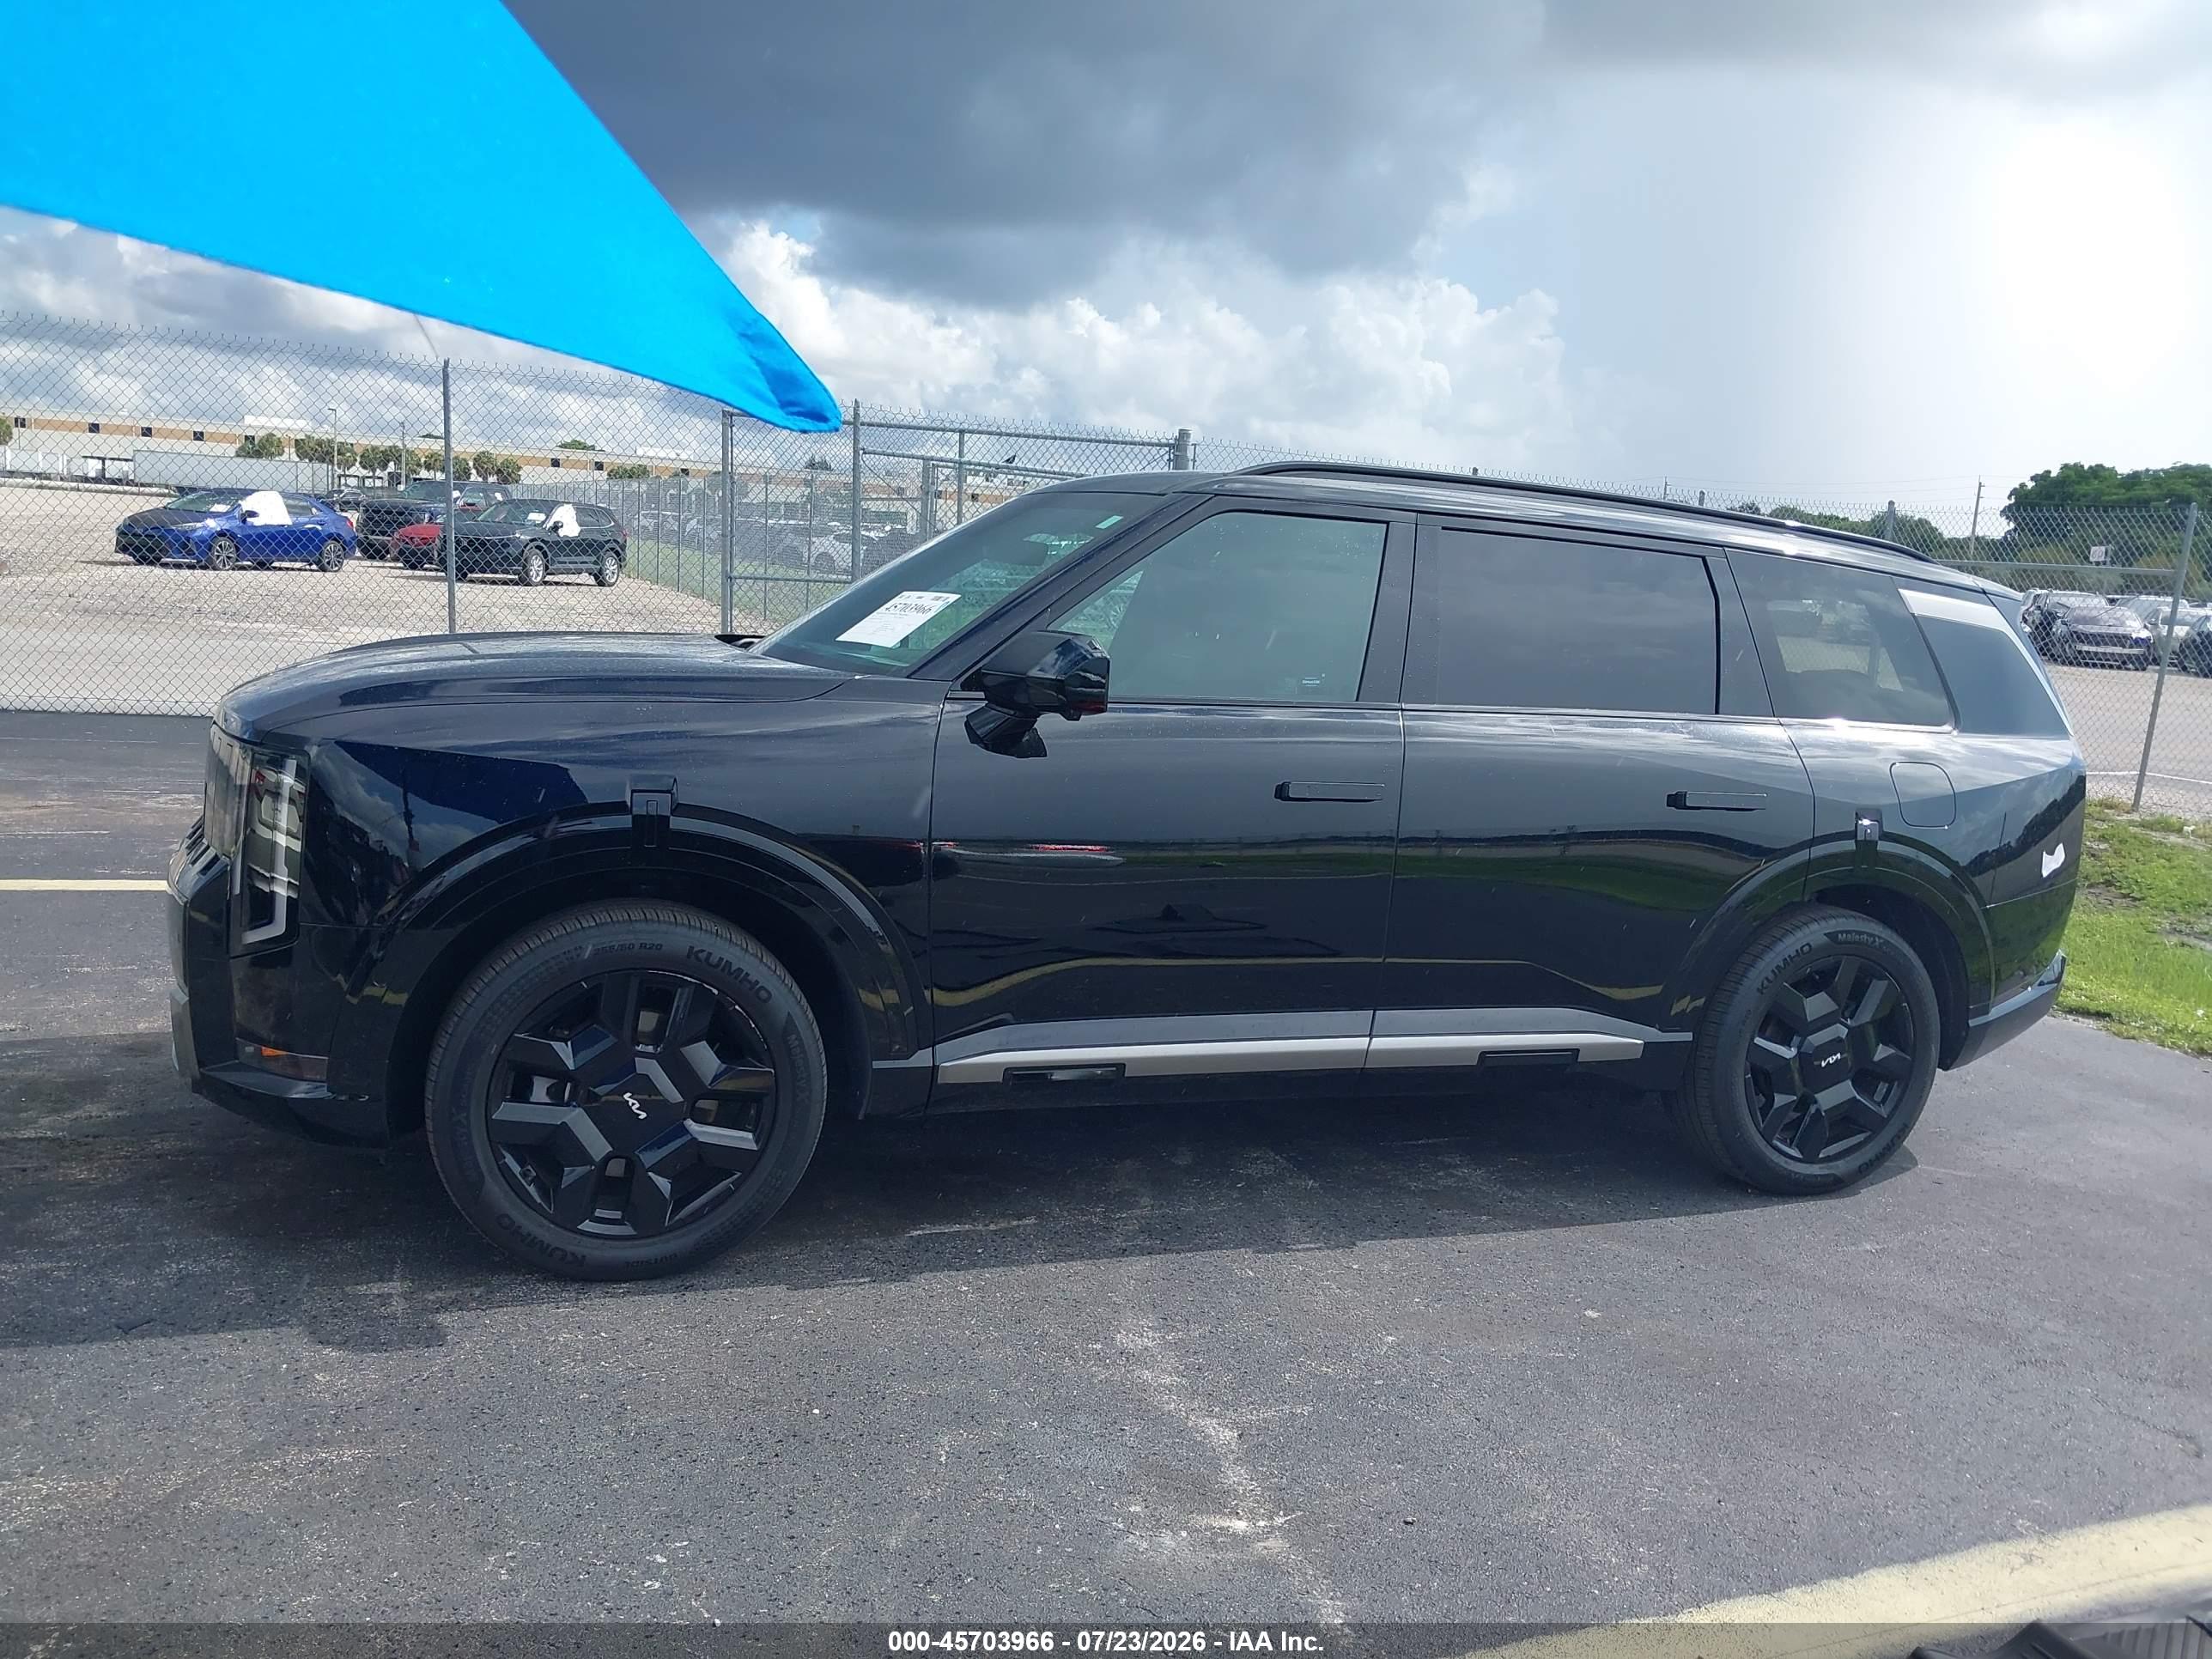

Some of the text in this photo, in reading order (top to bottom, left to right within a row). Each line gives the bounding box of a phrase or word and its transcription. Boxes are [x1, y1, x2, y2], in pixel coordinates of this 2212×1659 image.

[639, 942, 663, 951] R20
[1757, 942, 1813, 995] KUMHO
[686, 945, 773, 1004] KUMHO
[495, 1213, 586, 1268] KUMHO
